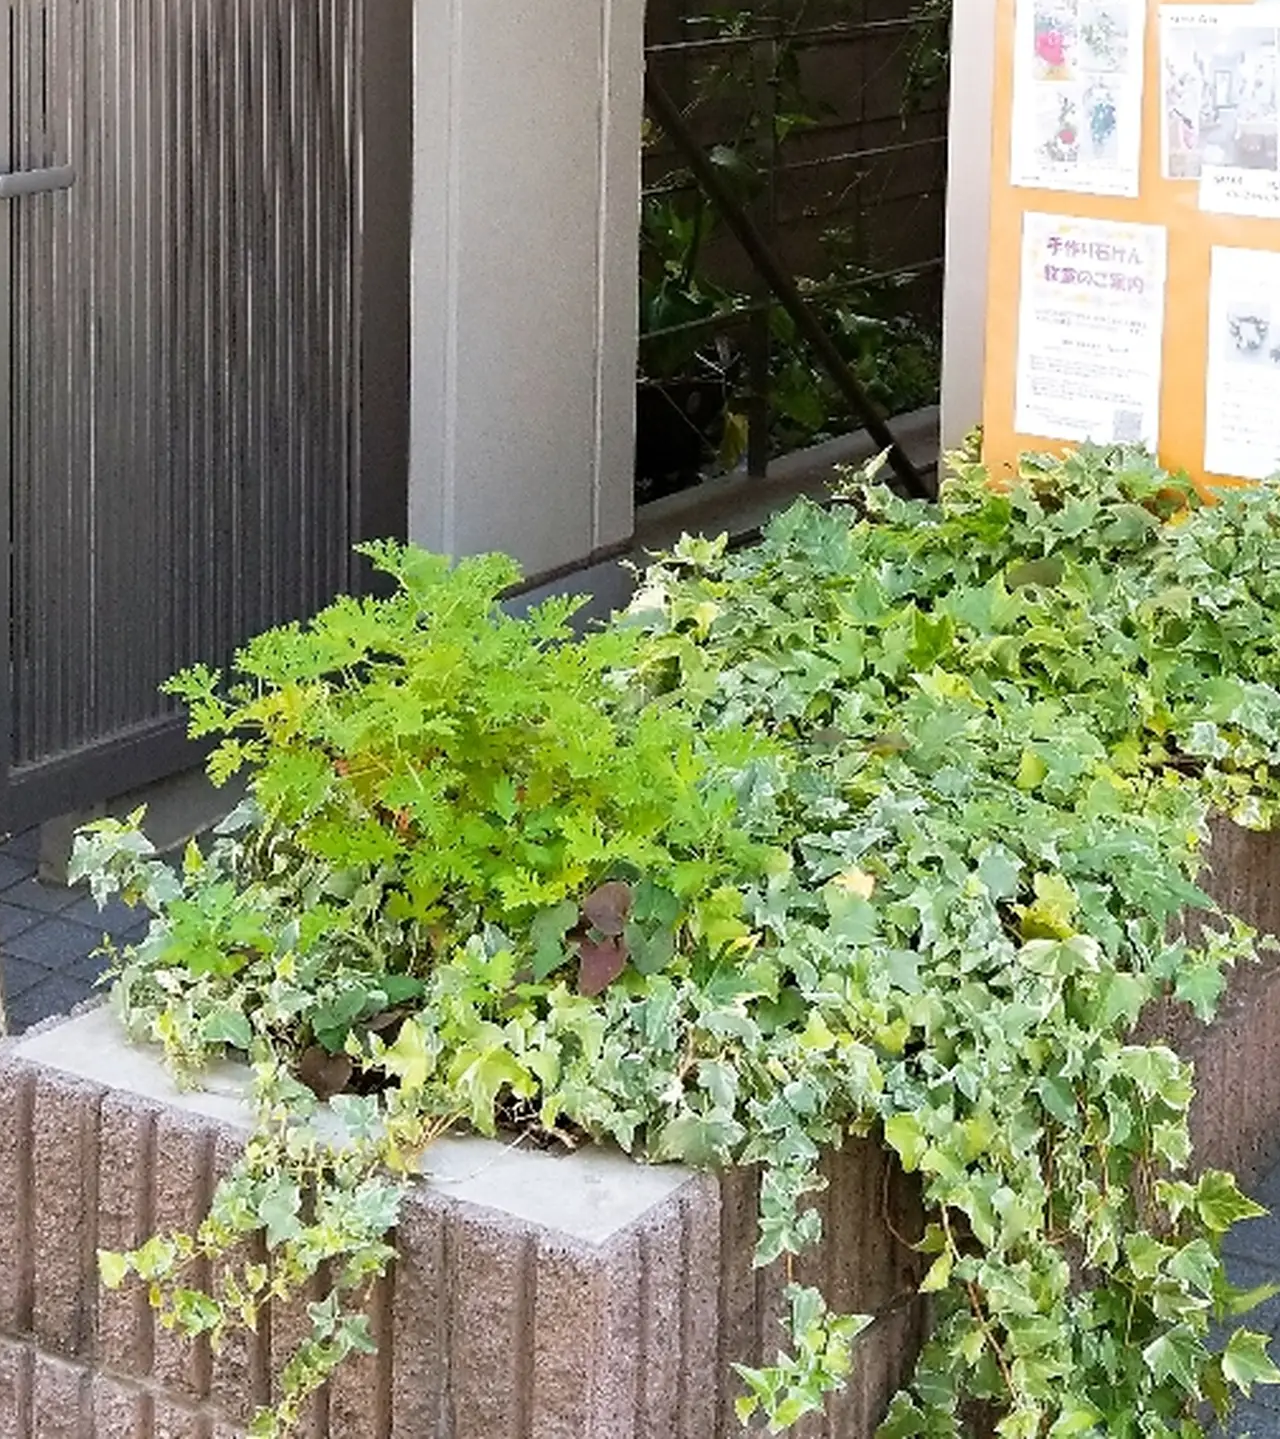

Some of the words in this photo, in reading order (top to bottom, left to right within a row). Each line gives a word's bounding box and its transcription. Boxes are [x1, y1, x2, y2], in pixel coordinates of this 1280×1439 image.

[1045, 236, 1145, 266] 手作り石けん
